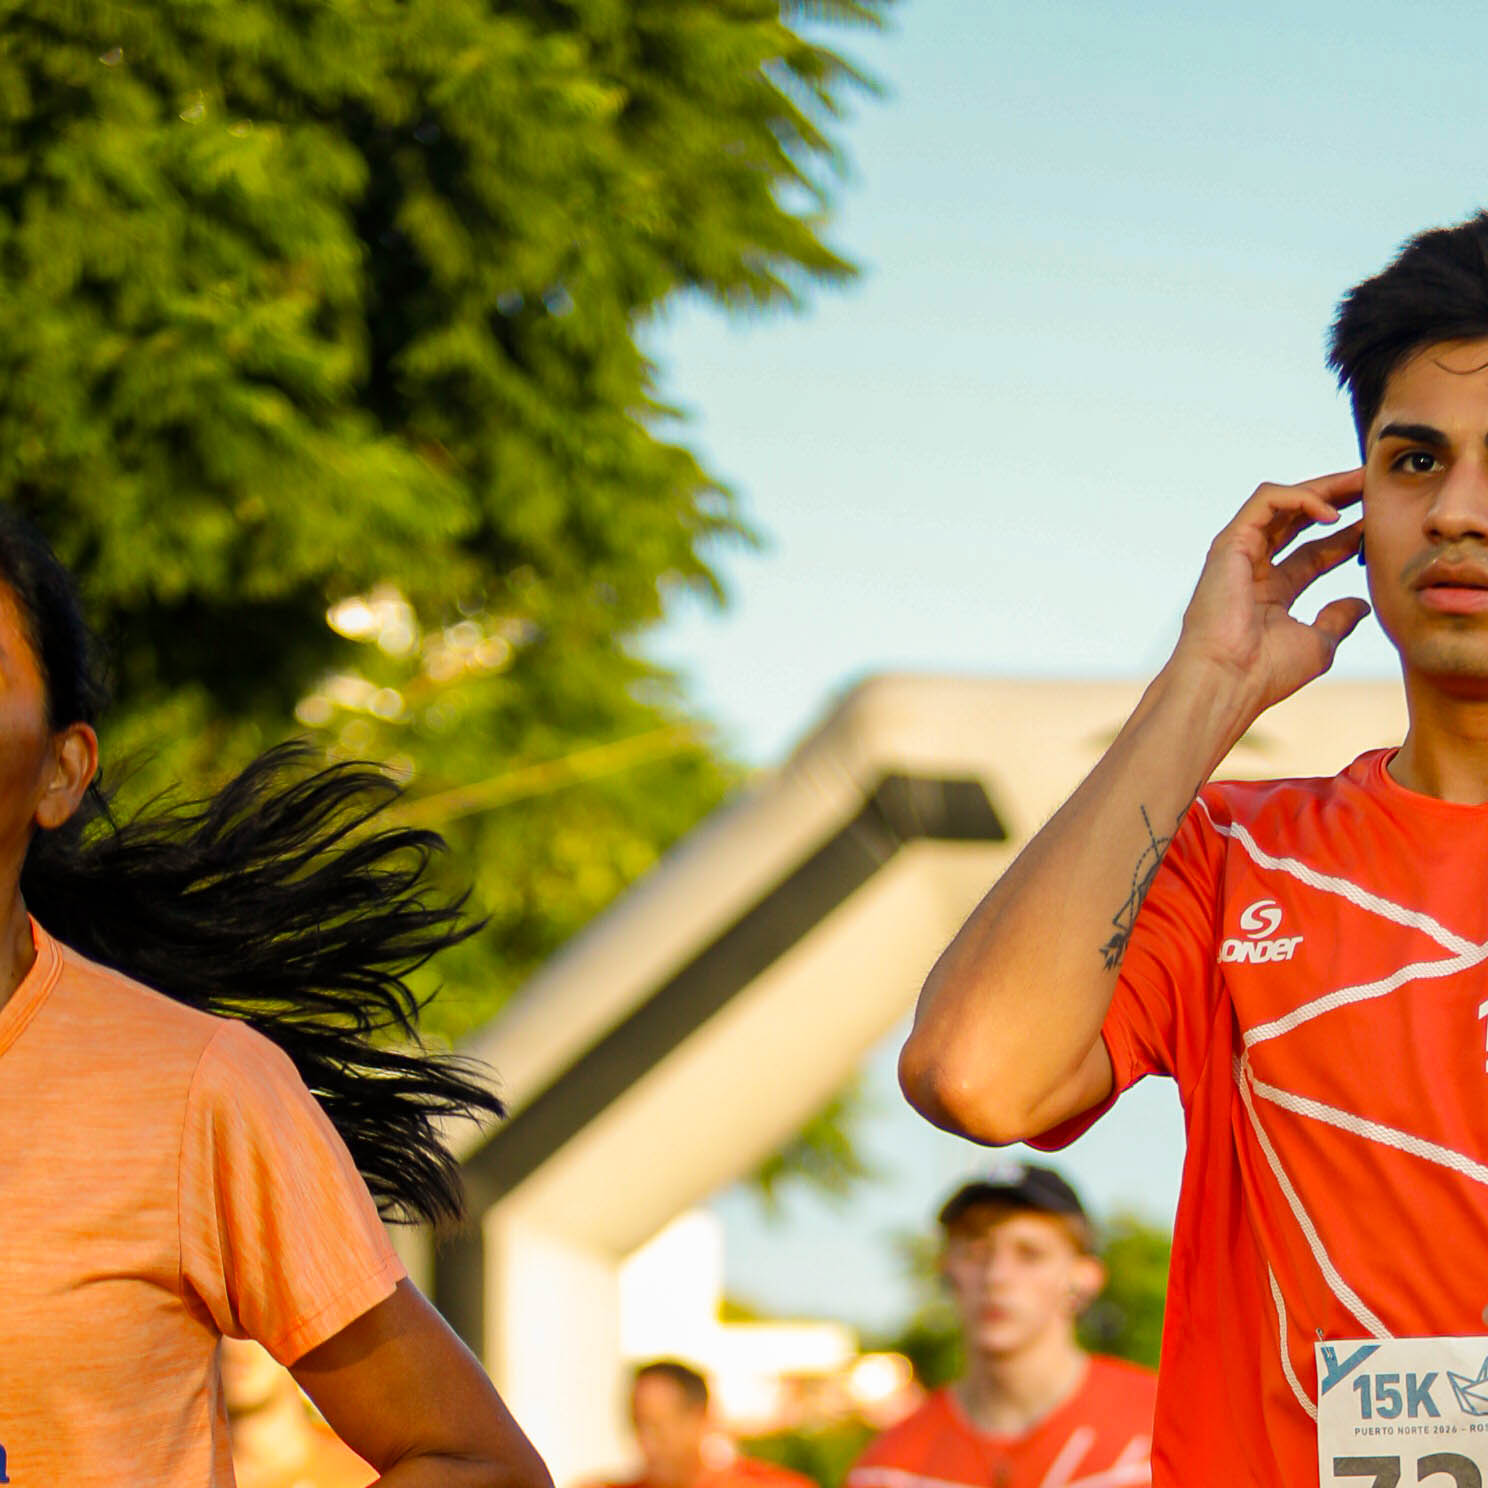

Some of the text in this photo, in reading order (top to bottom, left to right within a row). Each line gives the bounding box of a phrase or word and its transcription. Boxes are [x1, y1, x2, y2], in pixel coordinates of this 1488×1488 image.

[1353, 1372, 1441, 1419] 15K
[1354, 1425, 1394, 1436] PUERTO
[1398, 1425, 1430, 1435] NORTE
